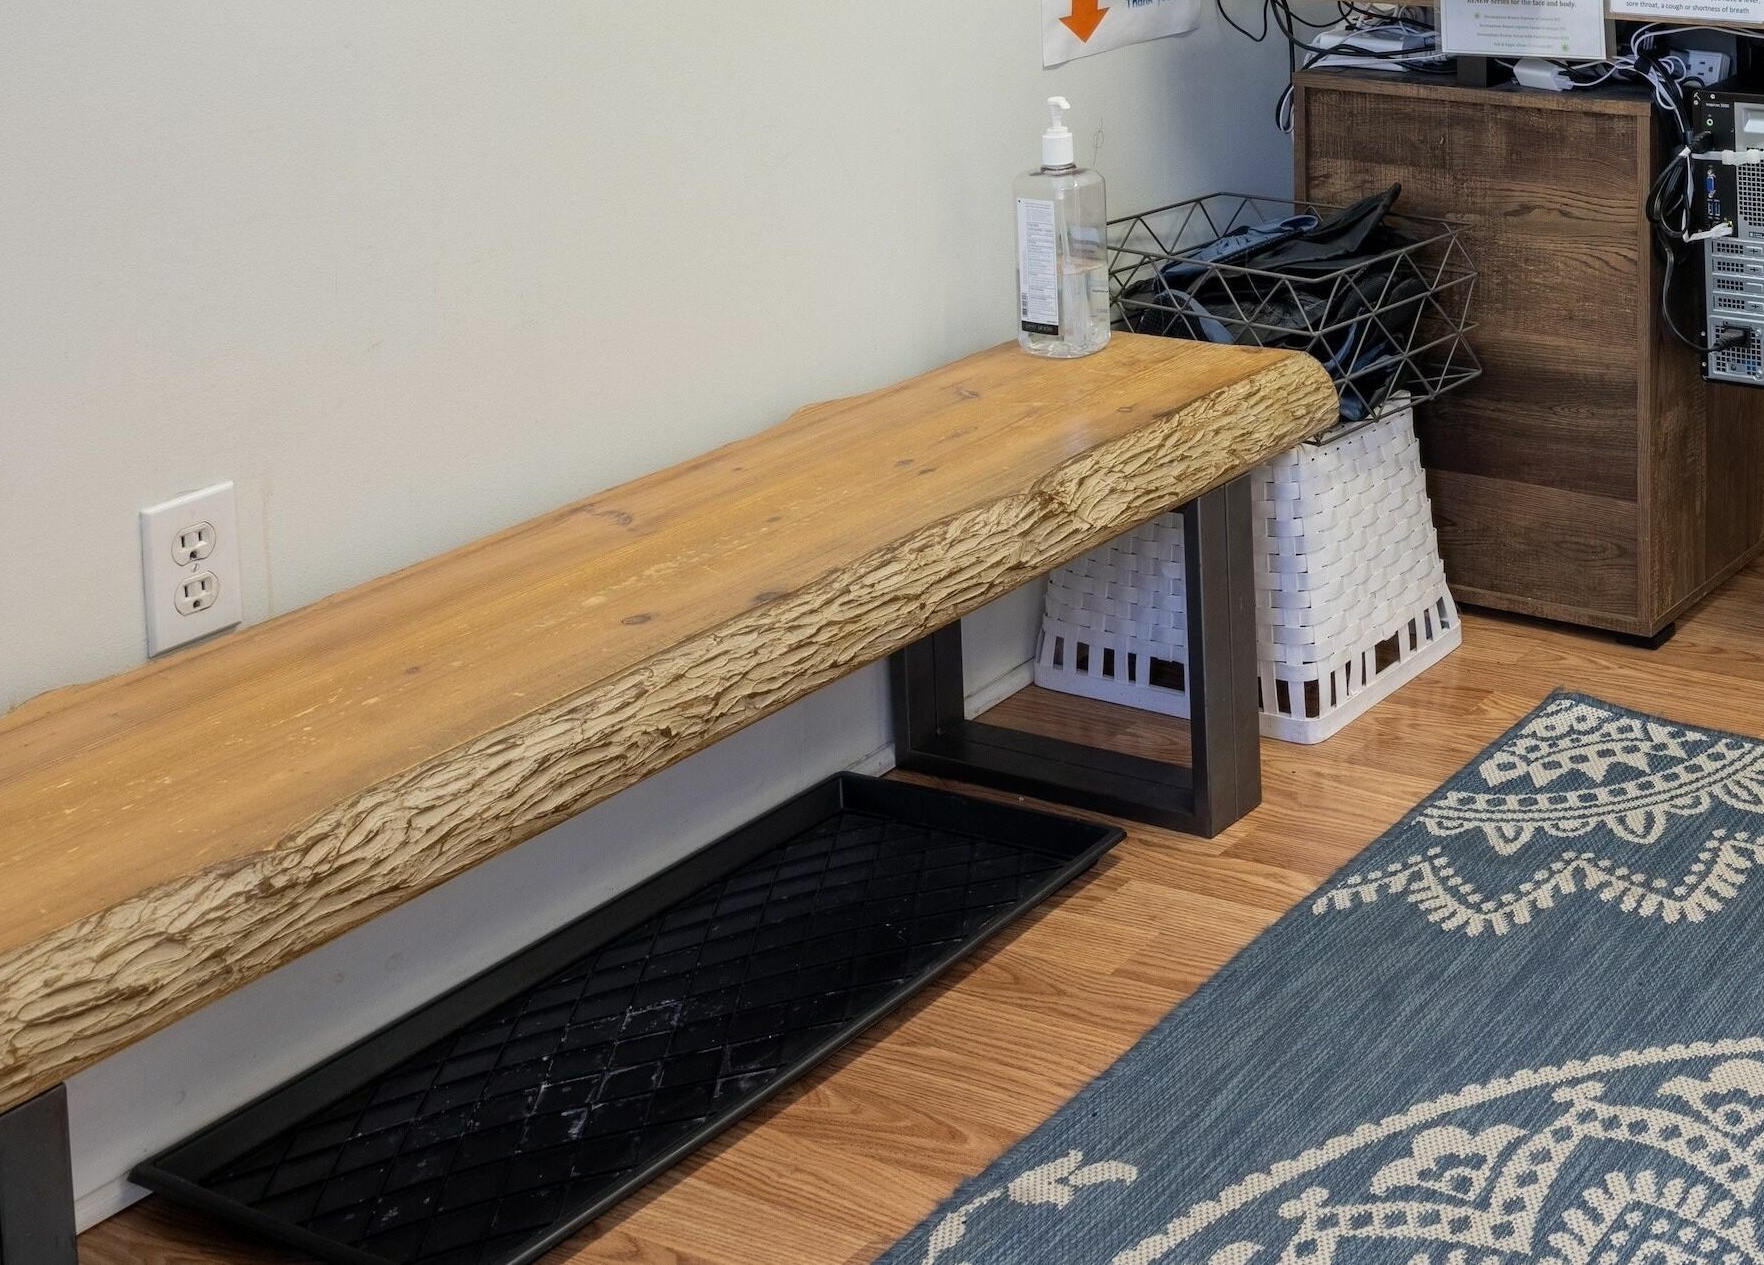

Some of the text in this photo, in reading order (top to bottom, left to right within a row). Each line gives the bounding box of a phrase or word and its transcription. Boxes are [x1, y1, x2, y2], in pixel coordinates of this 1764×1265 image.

[1559, 0, 1577, 8] body.
[1639, 0, 1660, 9] throat,
[1665, 3, 1684, 11] cough
[1692, 4, 1721, 13] shortness
[1729, 6, 1750, 15] breath
